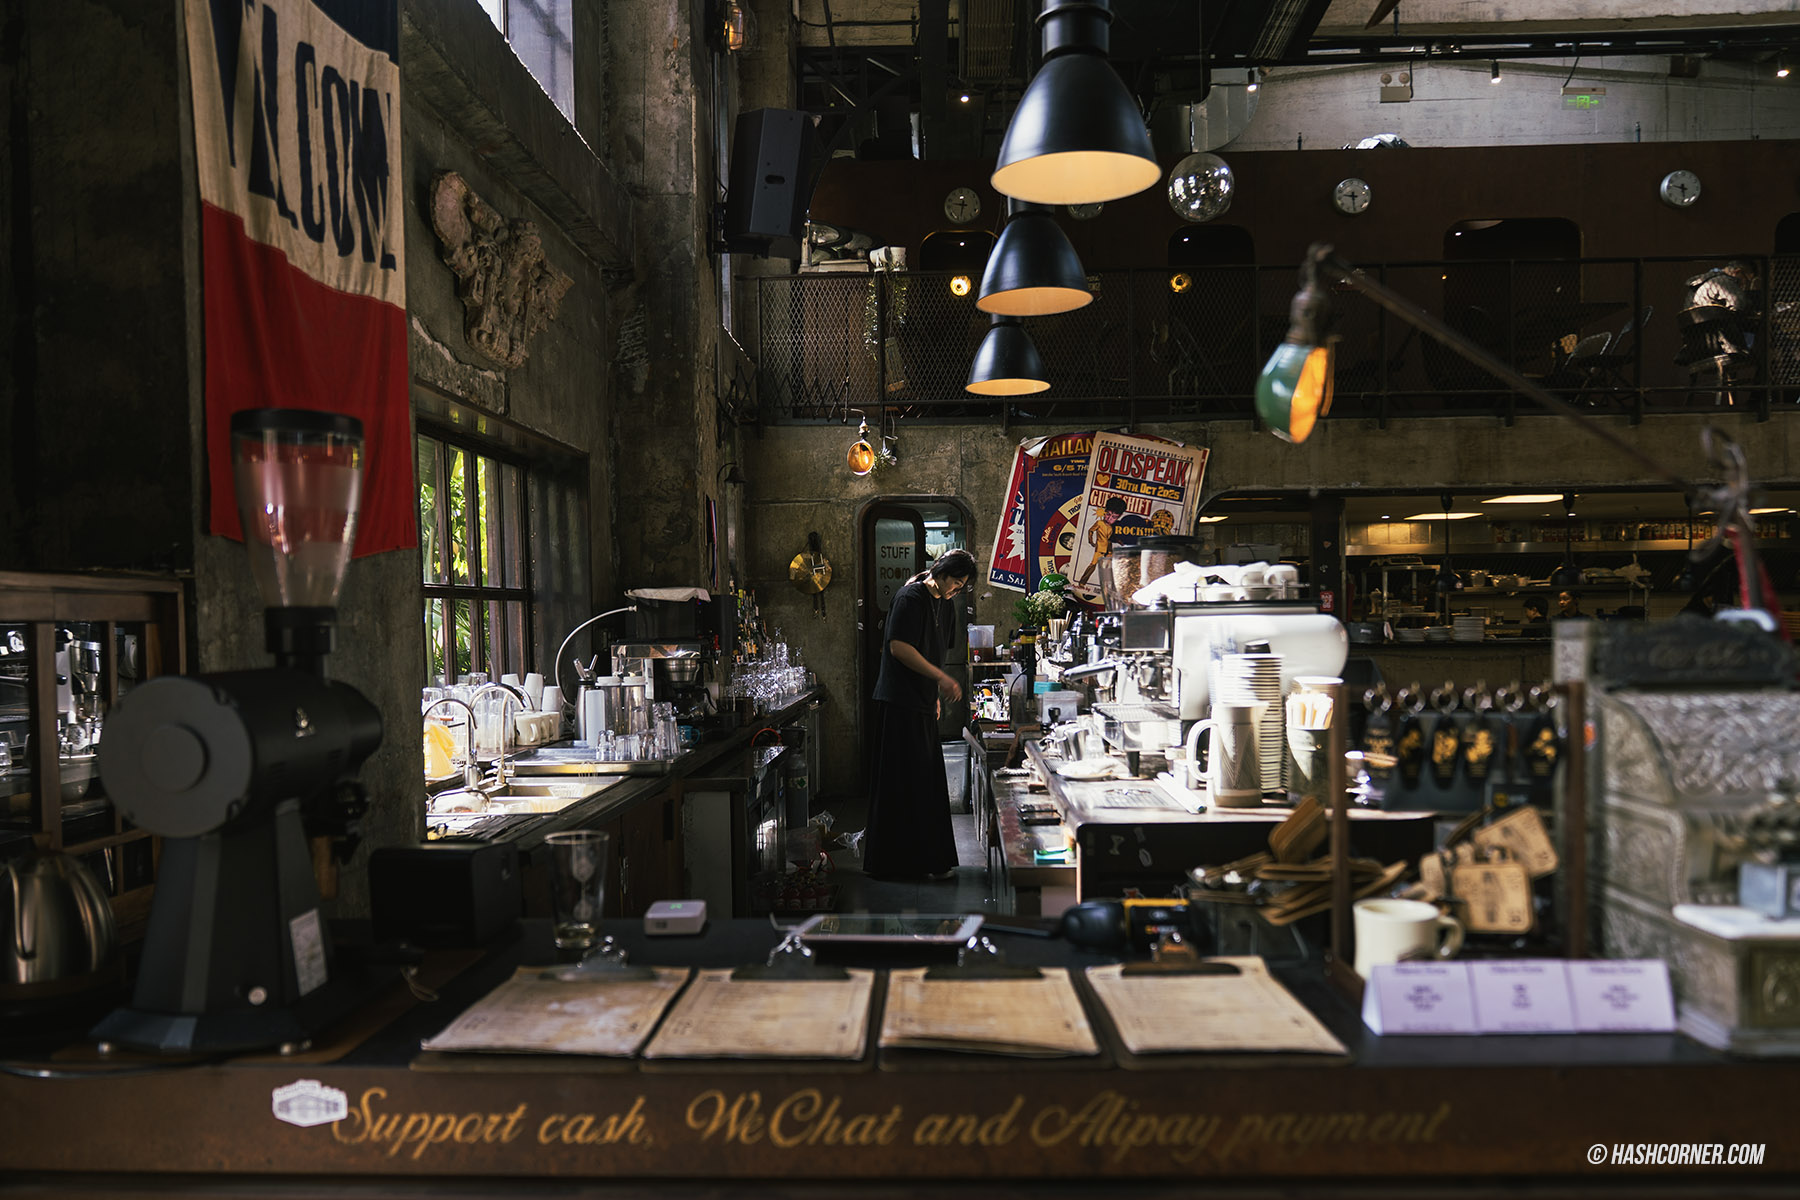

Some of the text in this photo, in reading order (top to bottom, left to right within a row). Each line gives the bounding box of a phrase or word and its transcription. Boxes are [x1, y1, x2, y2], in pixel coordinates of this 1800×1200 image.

[1033, 438, 1093, 459] HAILAN
[1098, 446, 1190, 487] OLDSPEAK
[1157, 486, 1181, 500] 2025
[1090, 489, 1152, 515] GUE SHIFT
[1115, 525, 1155, 537] ROCK!!!
[880, 546, 910, 559] STUFF
[991, 570, 1004, 580] LA
[332, 1086, 527, 1160] Support
[913, 1095, 1025, 1147] and
[1030, 1090, 1219, 1163] Alipay
